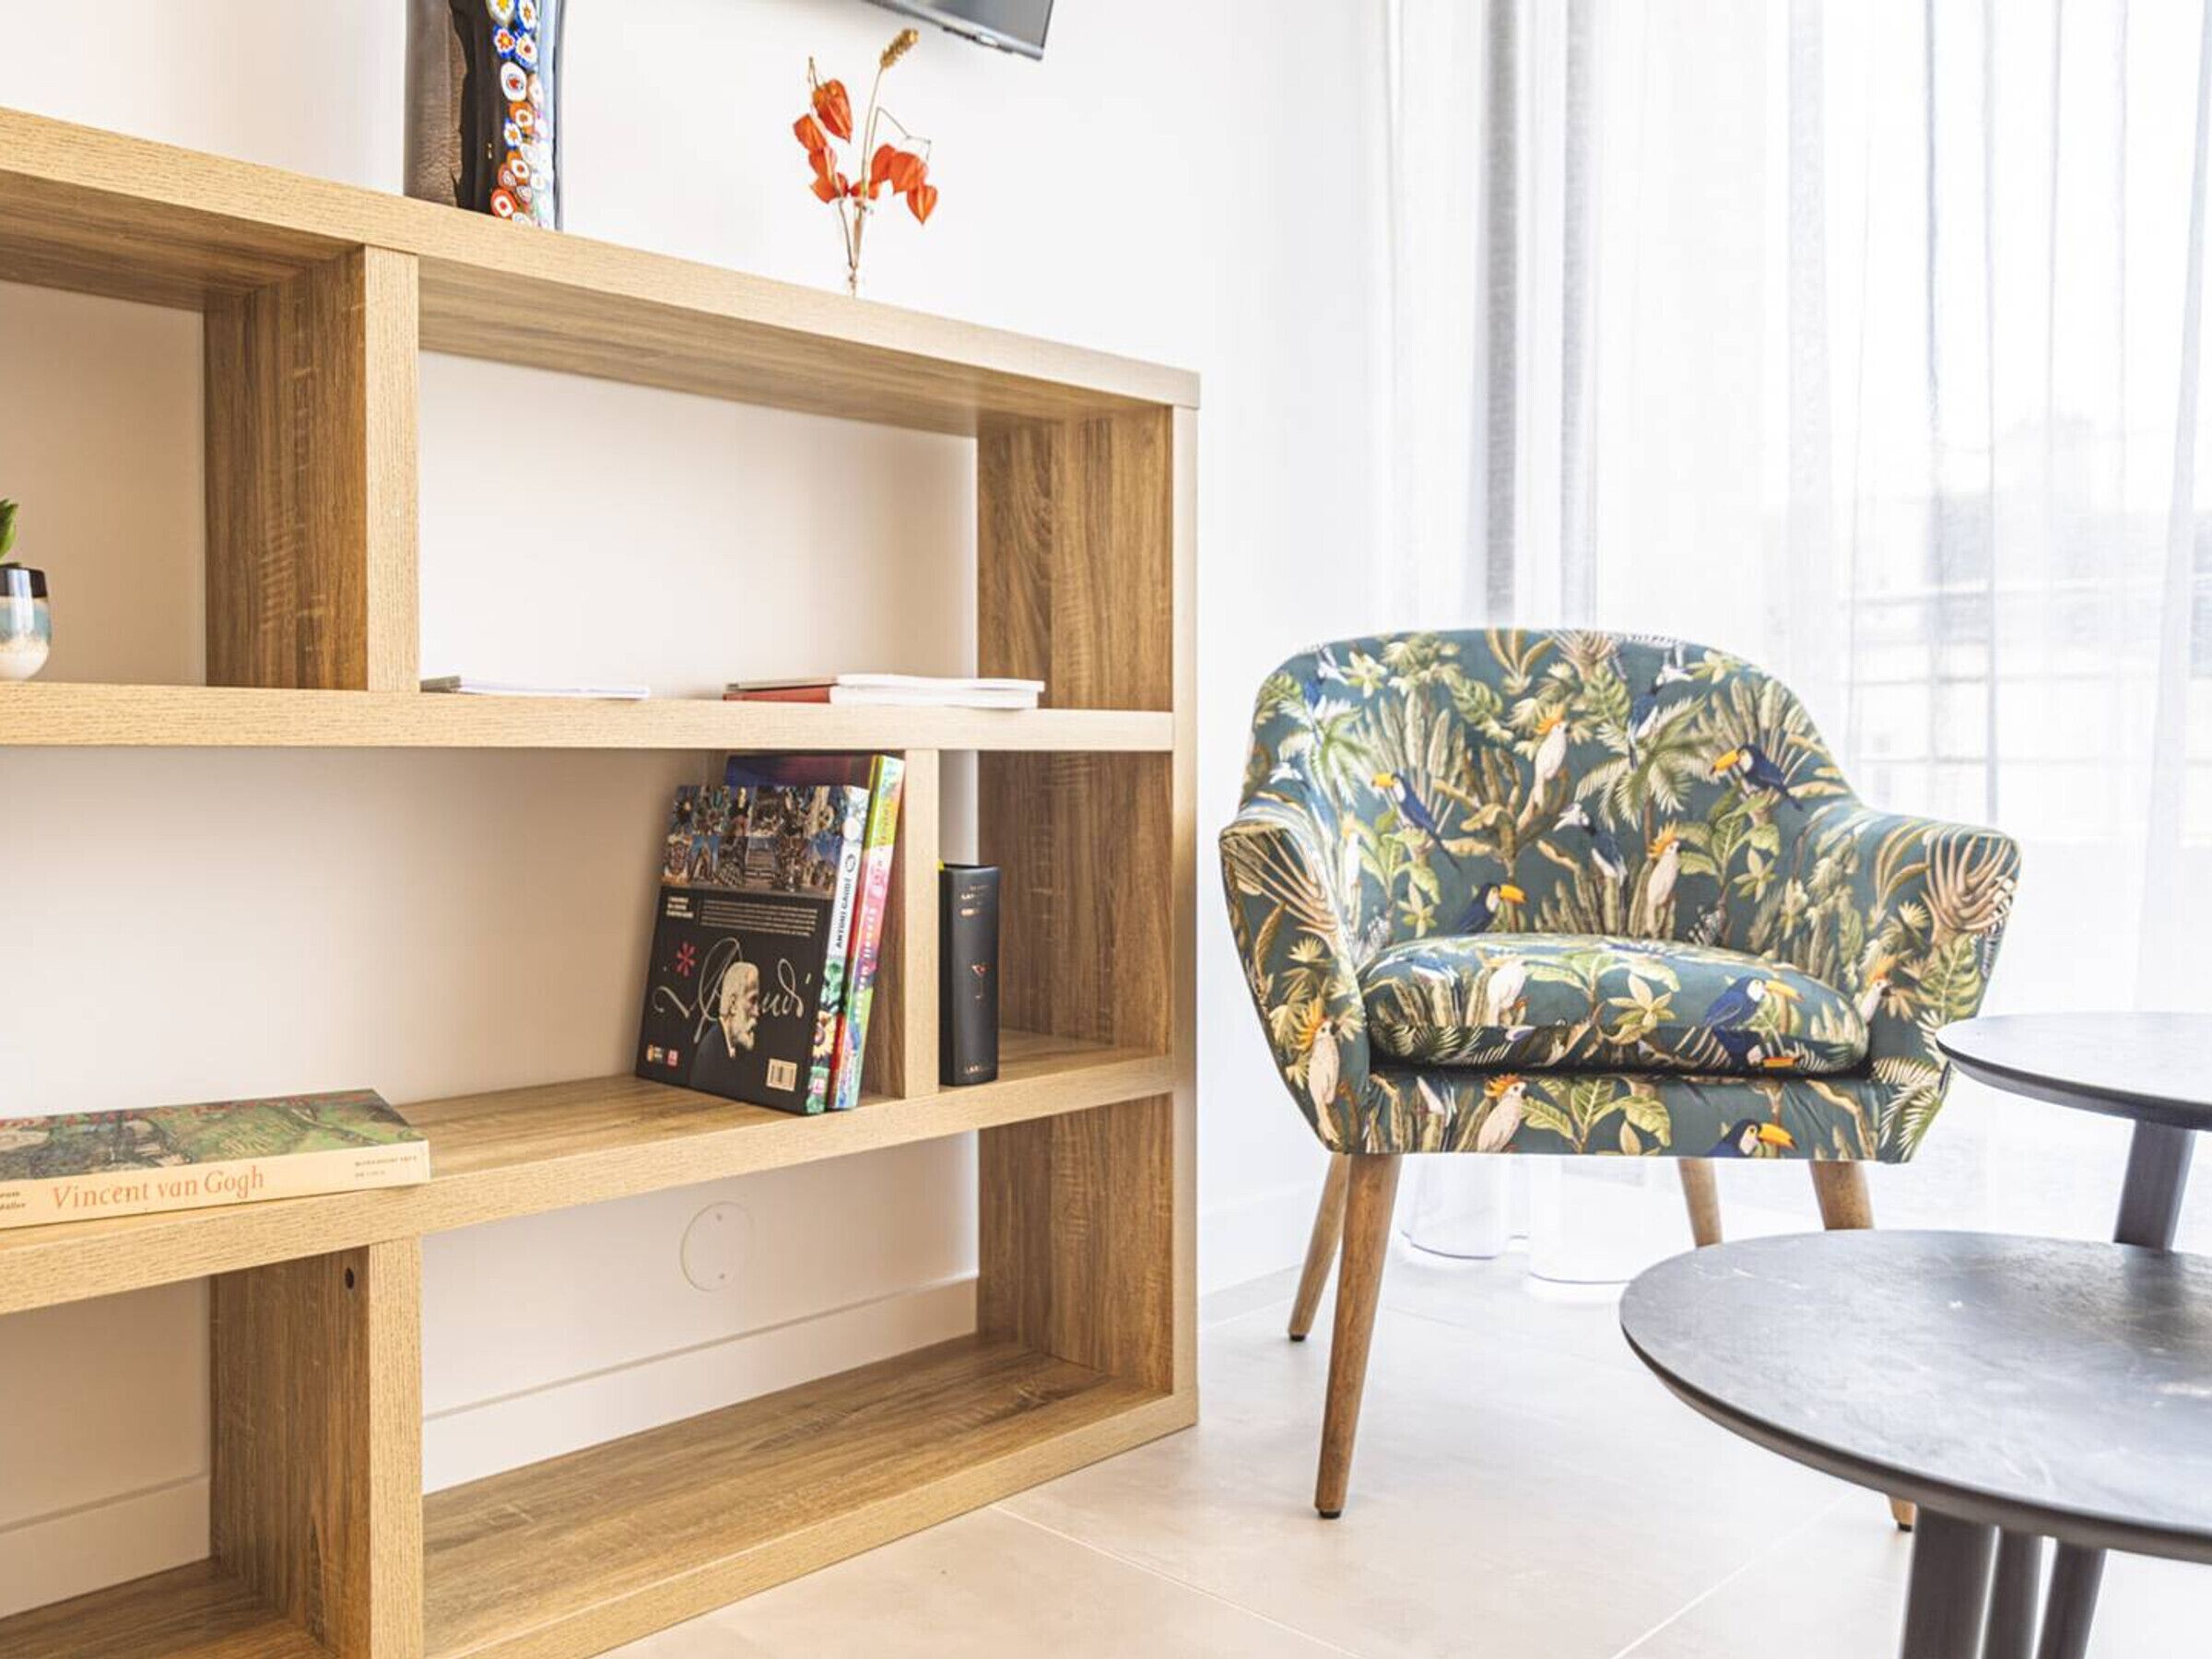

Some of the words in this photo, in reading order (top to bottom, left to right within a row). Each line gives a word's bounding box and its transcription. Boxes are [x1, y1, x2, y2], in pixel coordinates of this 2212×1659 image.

[53, 1182, 149, 1210] Vincent
[157, 1179, 199, 1198] van
[204, 1165, 264, 1198] Gogh
